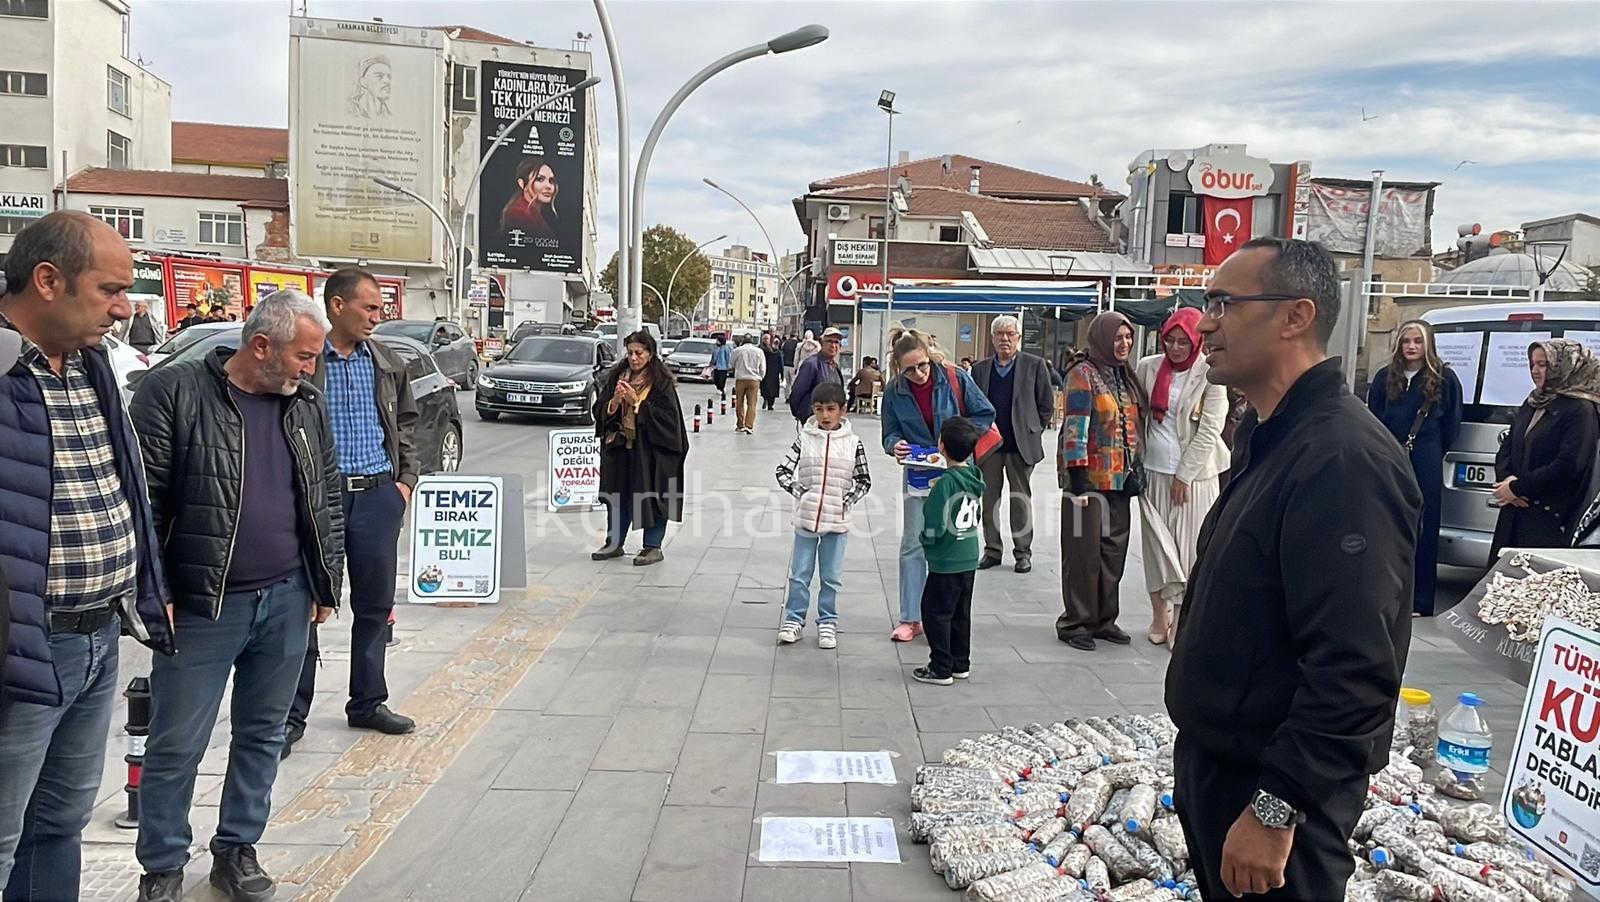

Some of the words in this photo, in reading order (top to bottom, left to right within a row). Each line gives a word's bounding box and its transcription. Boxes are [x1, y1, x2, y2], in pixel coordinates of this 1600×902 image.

[494, 77, 547, 94] KADINLARA
[491, 90, 513, 107] TEK
[515, 92, 577, 112] KURUMSAL
[534, 110, 571, 124] MERKEZİ
[556, 444, 601, 456] ÇÖPLÜK
[563, 455, 594, 466] DEĞİL!
[554, 467, 602, 479] VATAN
[1466, 466, 1486, 482] 06
[434, 510, 479, 522] BIRAK
[439, 549, 471, 561] BUL!
[1539, 678, 1600, 744] KÜ
[1534, 723, 1600, 780] TABLA
